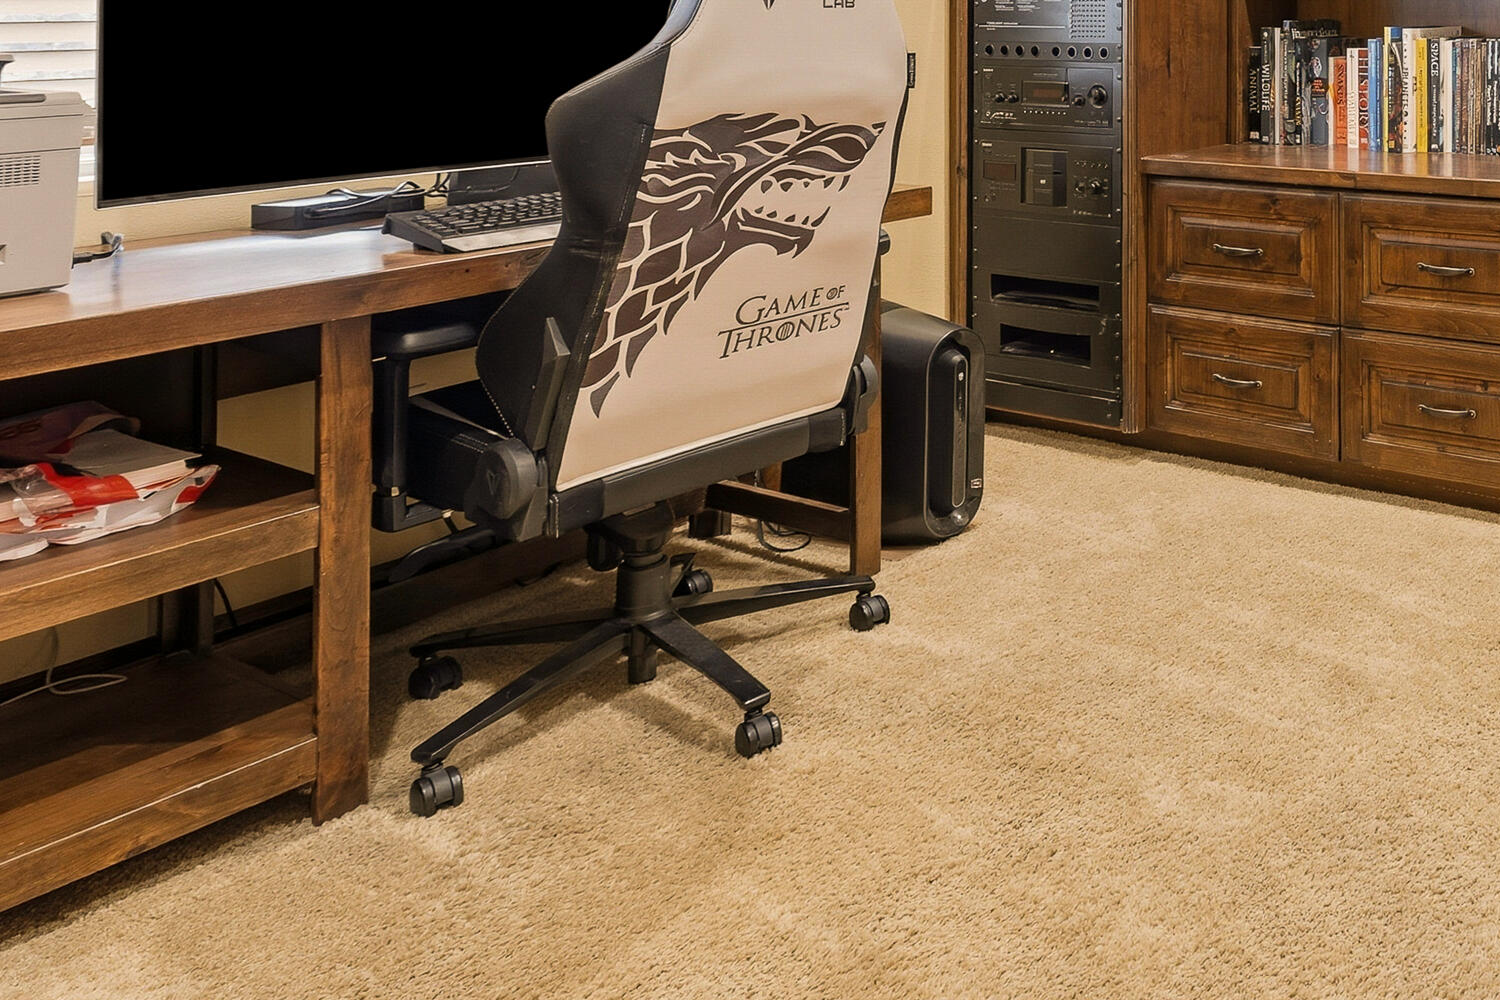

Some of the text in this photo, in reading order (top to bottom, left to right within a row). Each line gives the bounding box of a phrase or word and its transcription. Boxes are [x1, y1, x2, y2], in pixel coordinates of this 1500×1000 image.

[1430, 42, 1439, 76] SPACE
[1261, 64, 1270, 111] WILDLIFE
[736, 285, 846, 325] GAME OF
[718, 308, 843, 359] THRONES
